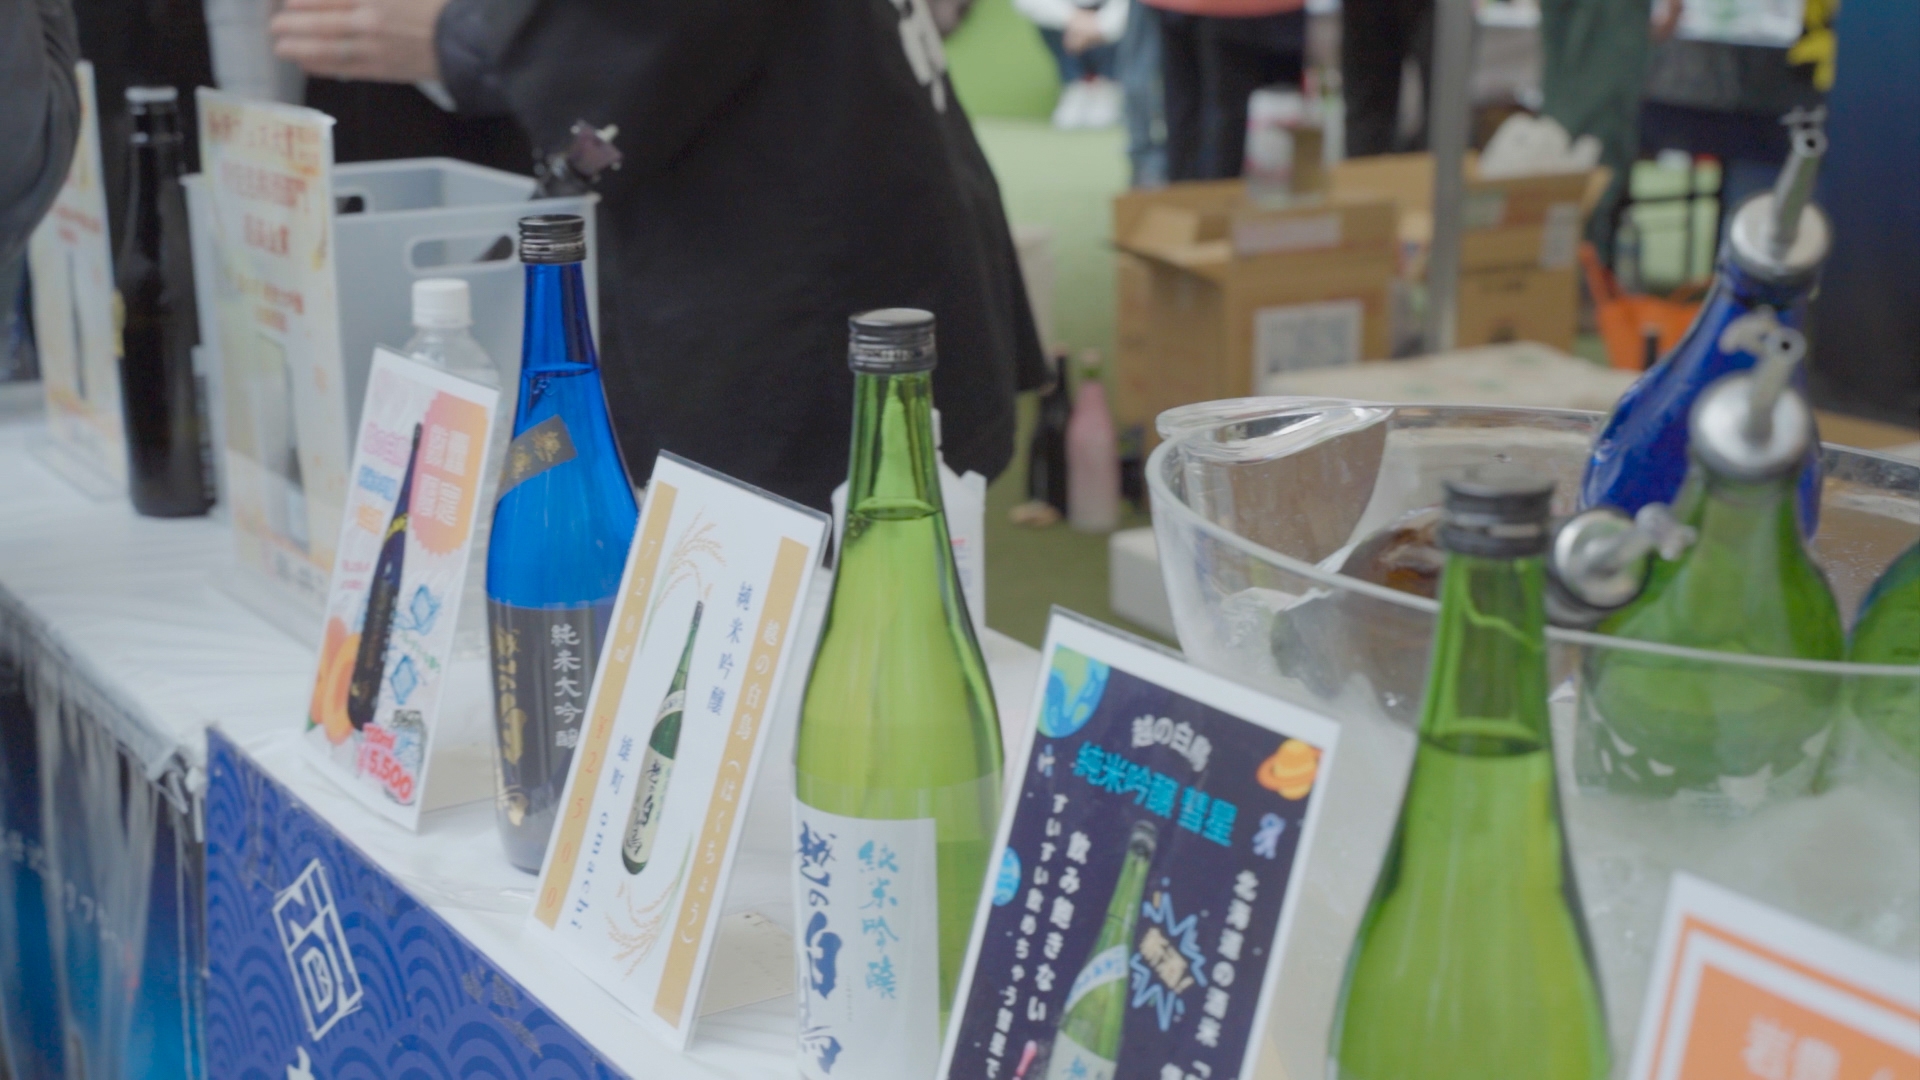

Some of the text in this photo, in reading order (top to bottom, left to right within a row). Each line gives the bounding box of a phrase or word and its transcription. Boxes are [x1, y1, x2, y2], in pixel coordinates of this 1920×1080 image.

[706, 580, 756, 716] 純米吟醸
[1072, 740, 1239, 848] 純米吟醸 彗星
[1130, 713, 1213, 774] 越の白鳥
[858, 839, 900, 1001] 純米吟醸
[1026, 831, 1093, 1023] 飲み飽きない
